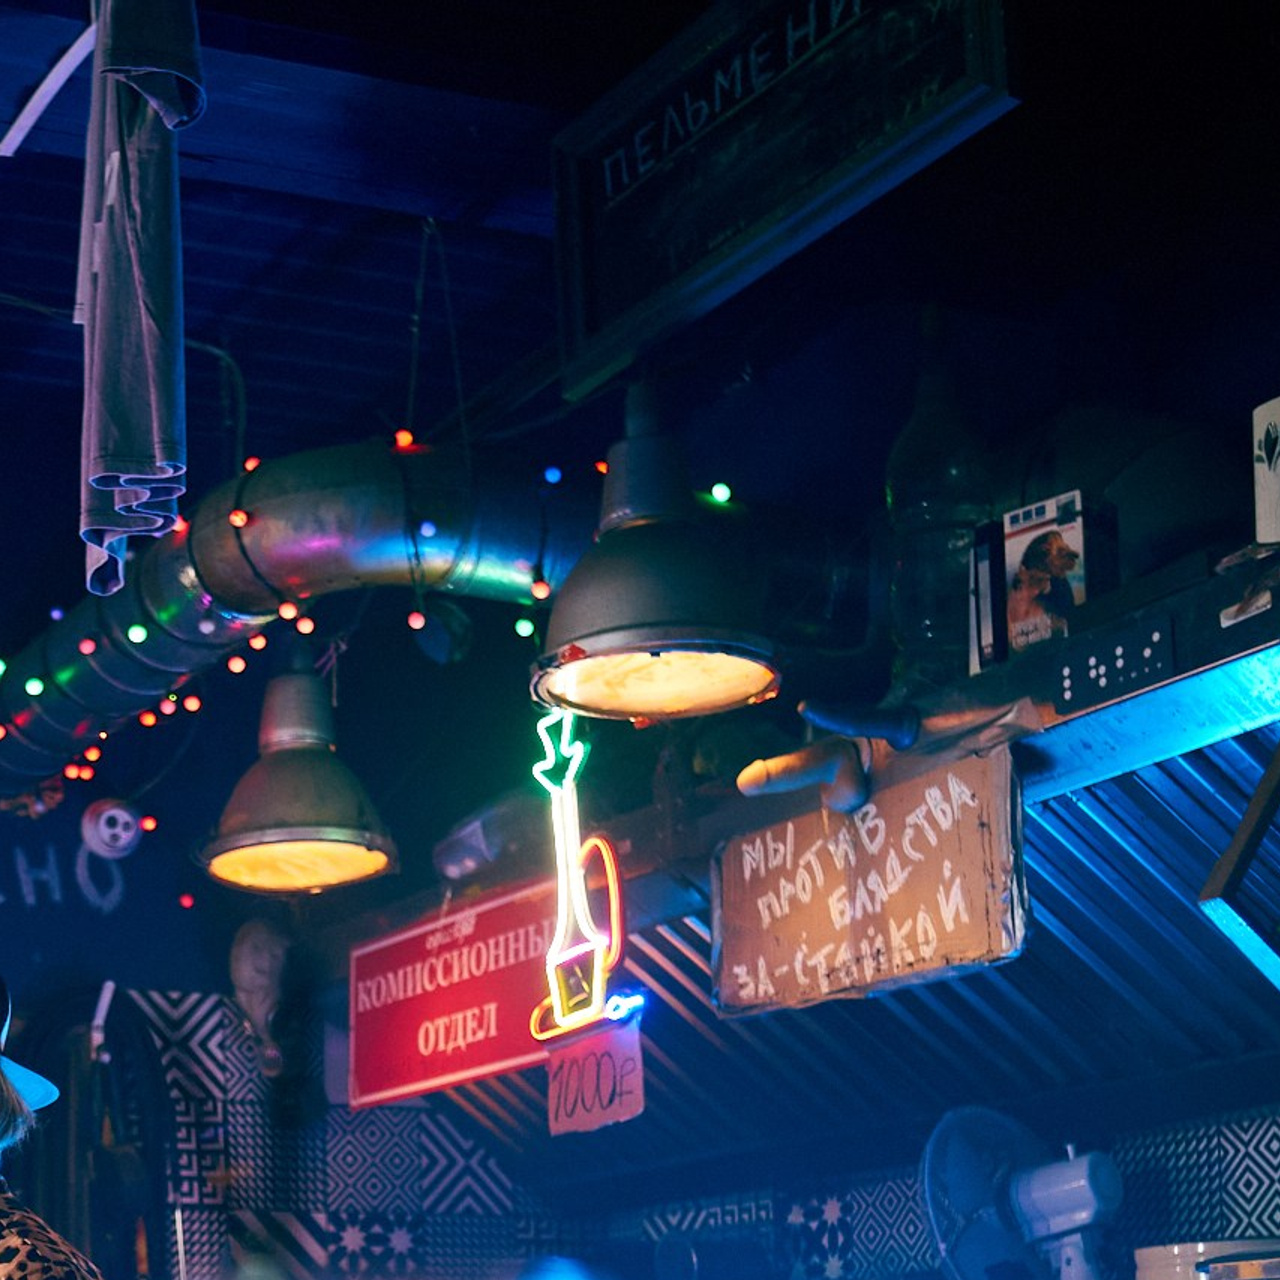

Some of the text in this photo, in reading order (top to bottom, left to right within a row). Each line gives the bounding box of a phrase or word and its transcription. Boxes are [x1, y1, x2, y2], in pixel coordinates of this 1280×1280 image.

[741, 820, 795, 883] МЫ
[756, 802, 887, 930] ПРОТИВ
[828, 772, 979, 931] БЛЯДСТВА
[356, 917, 558, 1014] КОМИССИОННЫ
[416, 1001, 499, 1057] ОТДЕЛ
